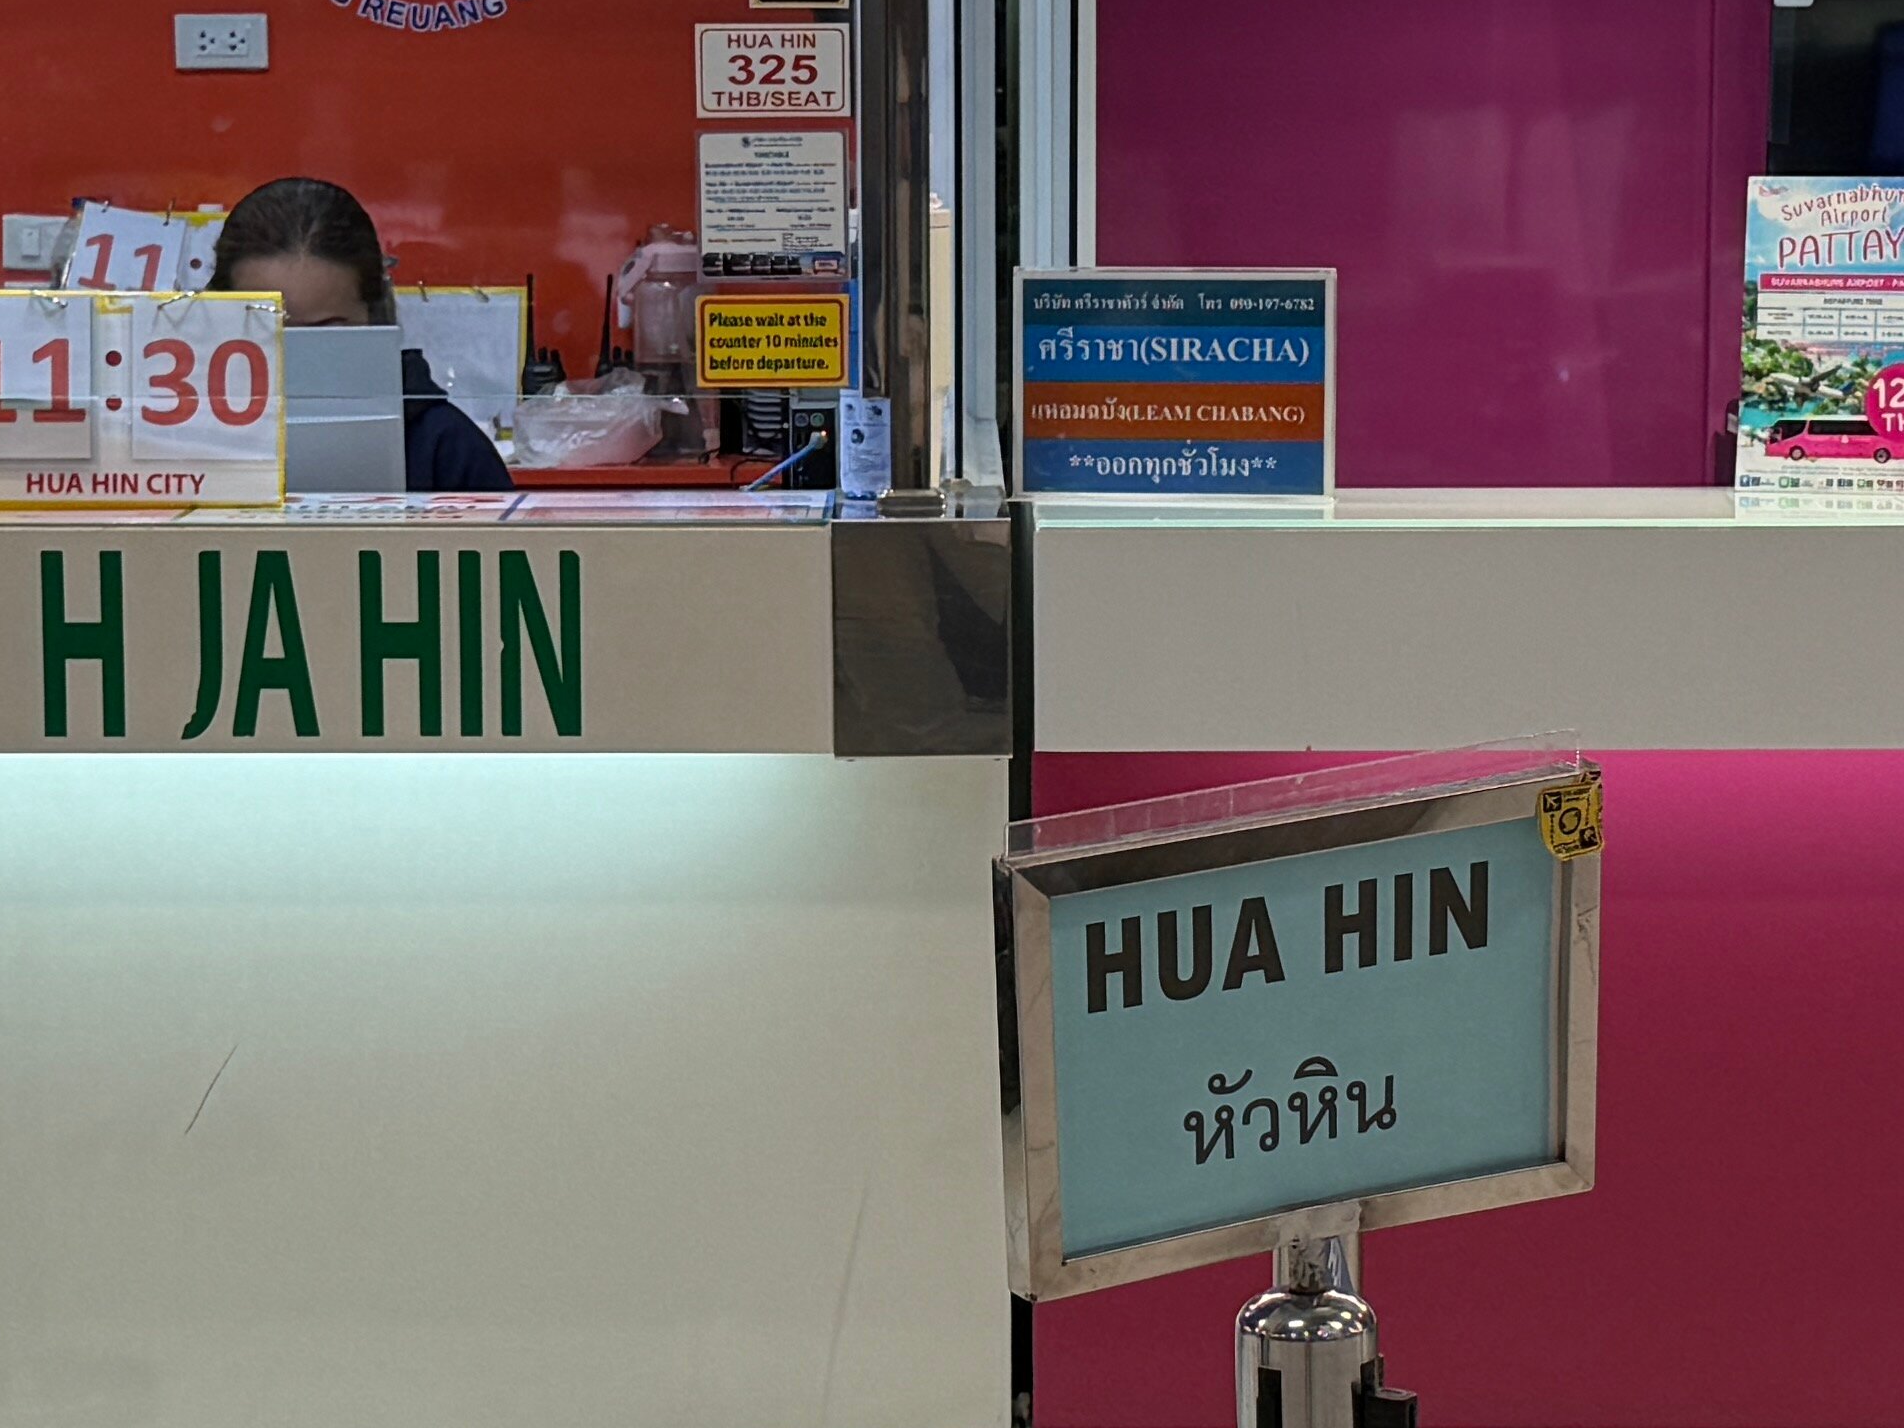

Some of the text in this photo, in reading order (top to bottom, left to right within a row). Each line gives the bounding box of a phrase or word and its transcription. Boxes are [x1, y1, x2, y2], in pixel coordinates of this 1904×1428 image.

[727, 33, 816, 49] HUA HIN
[727, 54, 818, 85] 325
[712, 90, 836, 107] THB/SEAT
[1821, 206, 1888, 227] Airport
[709, 312, 827, 327] Please wait at the
[709, 335, 838, 349] counter 10 minutes
[709, 355, 829, 373] before departure.
[1197, 405, 1305, 424] CHABANG)
[26, 473, 206, 495] HUA HIN CITY
[359, 549, 582, 737] HIN
[1085, 860, 1490, 1015] HUA HIN
[1183, 1056, 1398, 1166] หัวหิน
